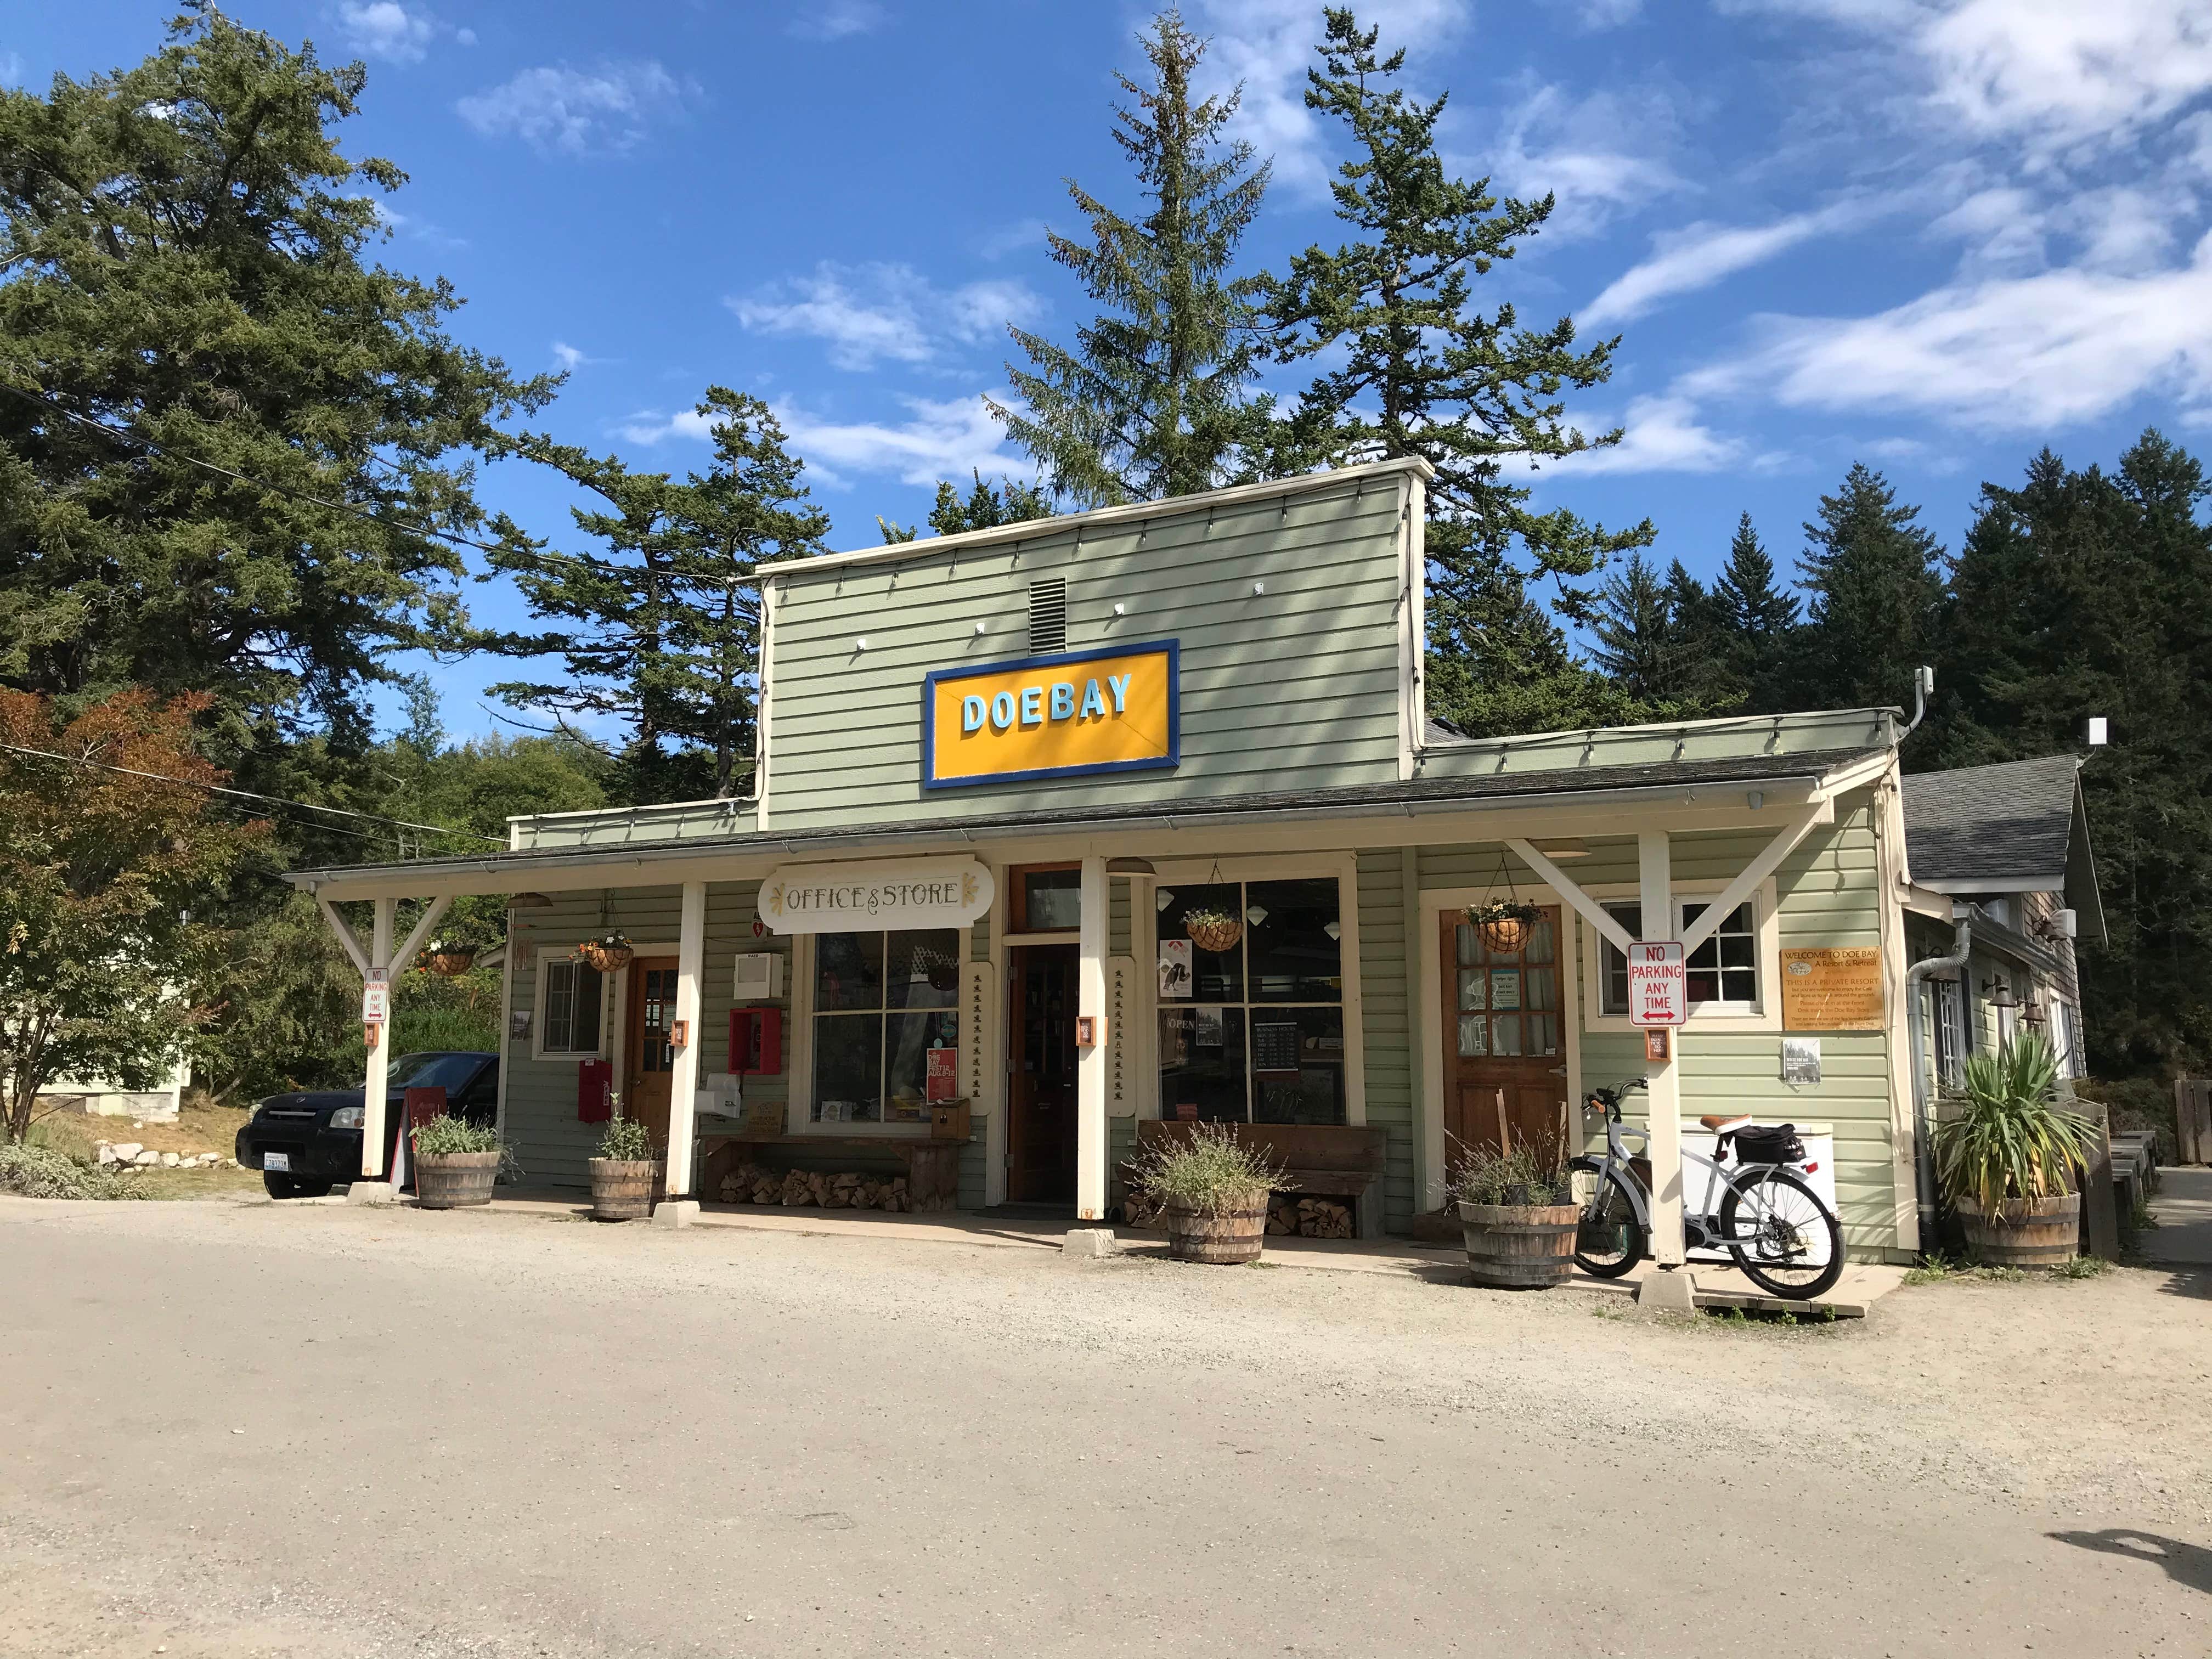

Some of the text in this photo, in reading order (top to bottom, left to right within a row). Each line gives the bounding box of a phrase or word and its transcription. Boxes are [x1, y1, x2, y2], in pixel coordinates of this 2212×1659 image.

[964, 674, 1132, 731] DOEBAY
[787, 887, 865, 910] OFFICE
[883, 883, 958, 906] STORE
[1646, 946, 1665, 962] NO
[373, 970, 381, 981] NO
[1632, 966, 1681, 979] PARKING
[365, 983, 387, 991] PARKING
[1645, 983, 1669, 994] ANY
[369, 1003, 381, 1011] TIME
[1644, 997, 1671, 1009] TIME
[1169, 1018, 1194, 1030] OPEN
